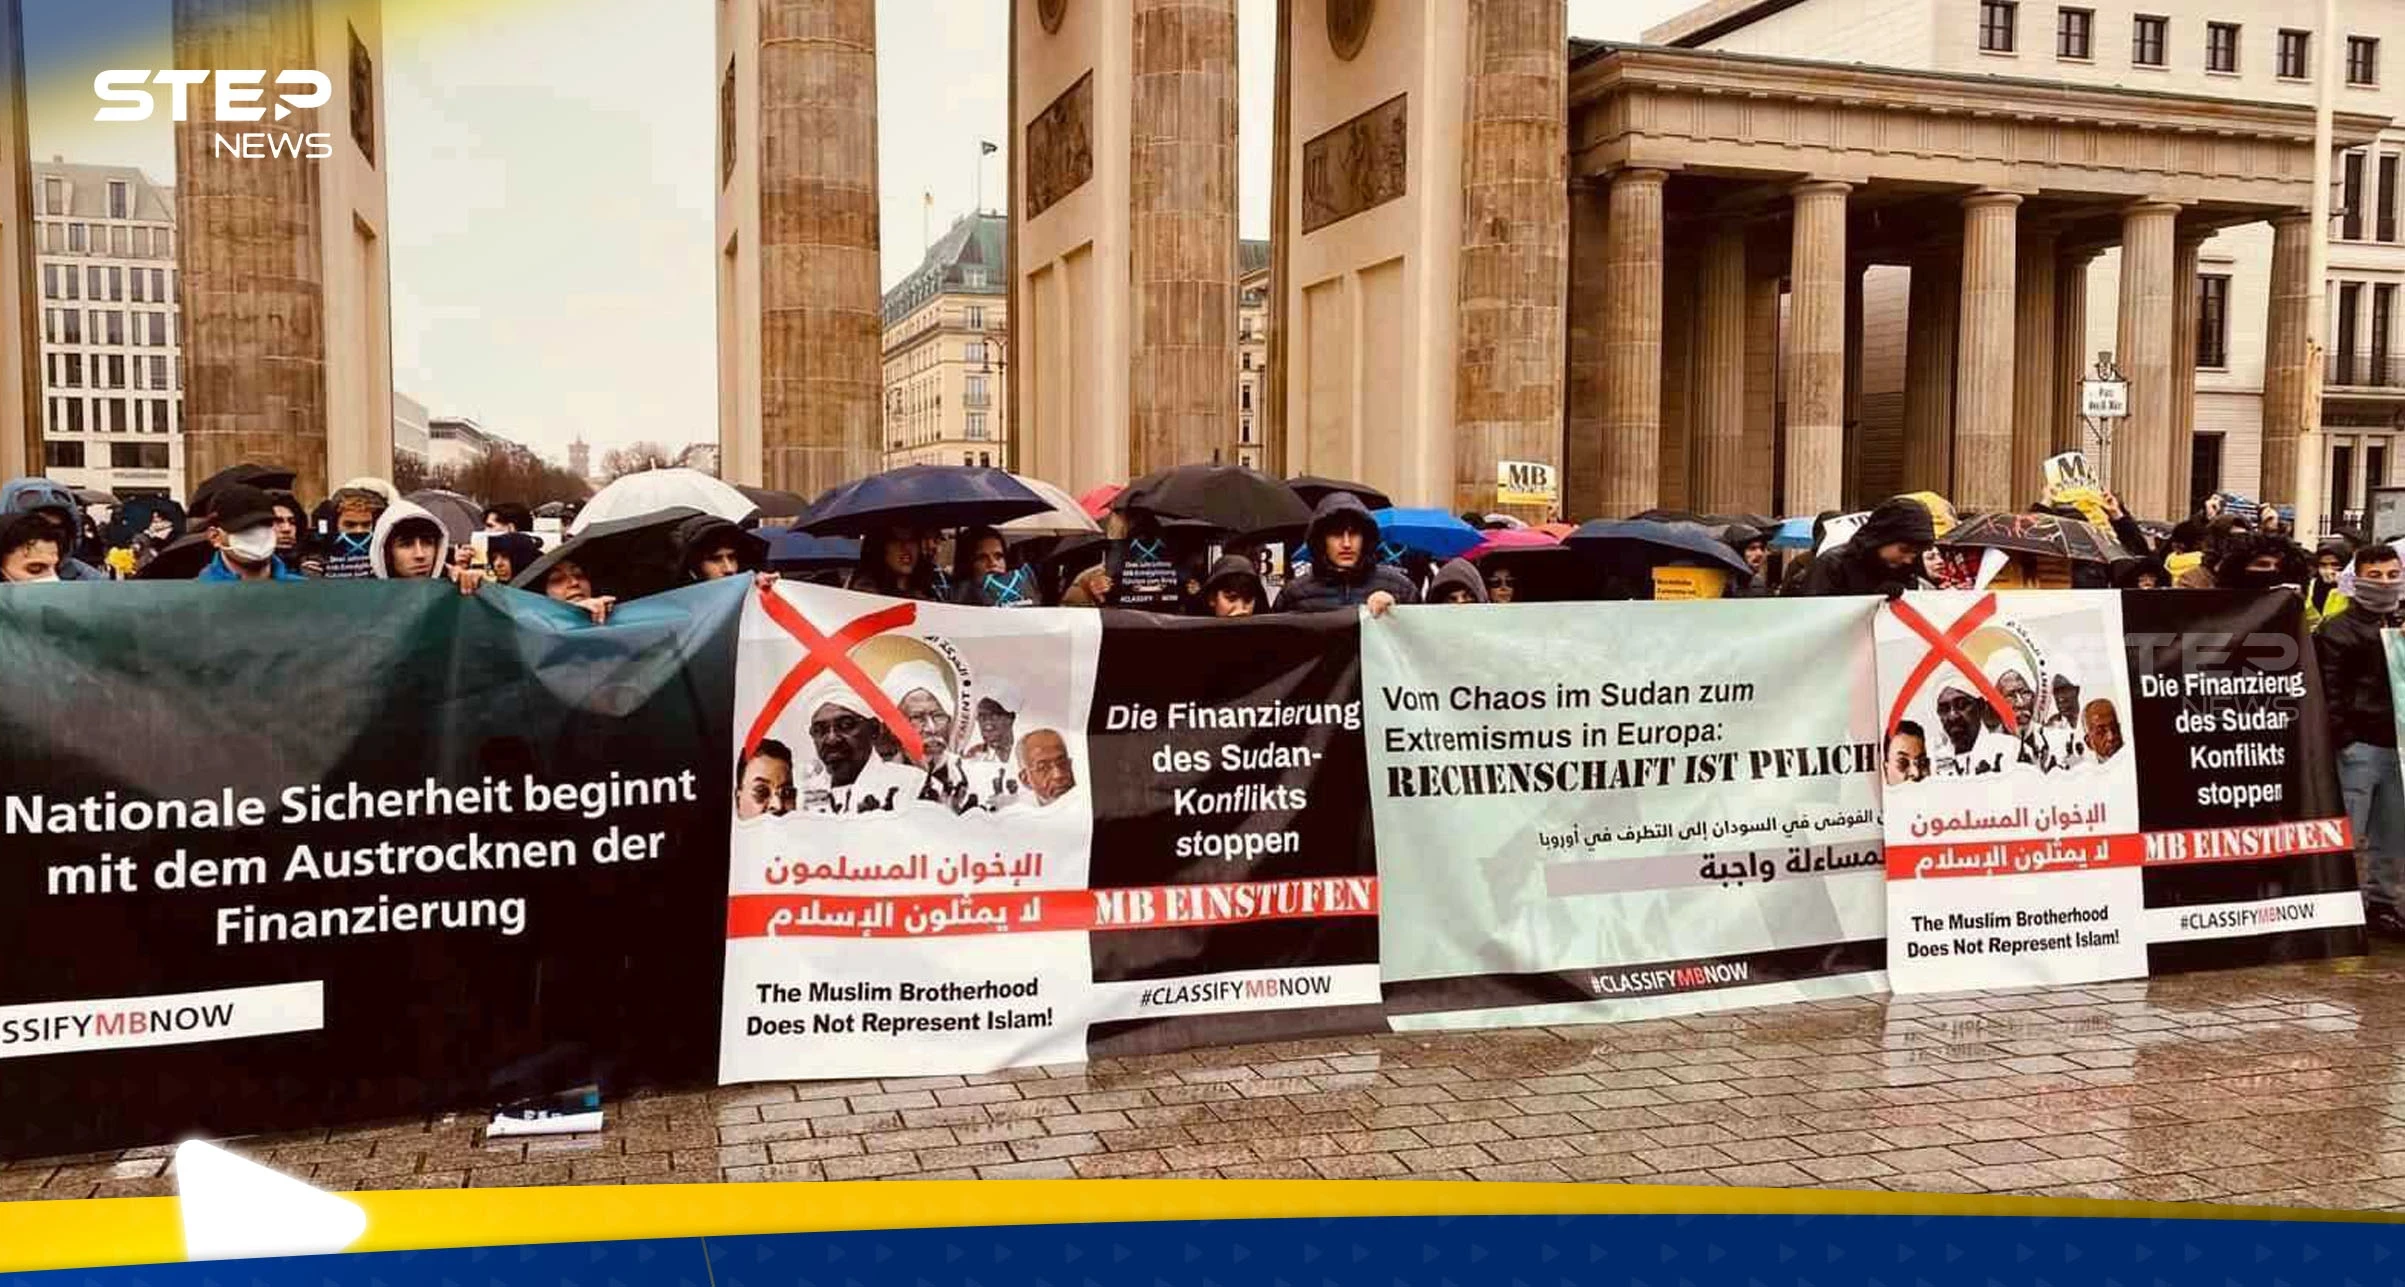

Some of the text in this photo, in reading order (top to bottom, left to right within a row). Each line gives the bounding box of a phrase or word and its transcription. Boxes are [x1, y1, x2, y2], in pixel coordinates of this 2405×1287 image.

[1510, 464, 1547, 486] MB
[1382, 680, 1754, 711] Vom Chaos im Sudan zum
[2141, 673, 2179, 698] Die
[1106, 699, 1362, 731] Die Finanzierung
[2175, 709, 2216, 734] des
[1385, 722, 1723, 752] Extremismus in Europa:
[1152, 742, 1322, 773] des Sudan-
[2190, 742, 2285, 769] Konflikts
[1387, 756, 1676, 798] RECHENSCHAFT
[1684, 752, 1739, 785] IST
[5, 769, 697, 834] Nationale Sicherheit beginnt
[1174, 784, 1308, 816] Konflikts
[1679, 821, 1707, 841] إلى
[1712, 817, 1776, 839] السودان
[1782, 814, 1810, 838] في
[1814, 809, 1873, 831] الفوضى
[1911, 807, 2028, 837] المسلمون
[2035, 802, 2106, 832] الإخوان
[1176, 830, 1300, 861] stoppen
[1585, 827, 1612, 851] في
[1617, 822, 1673, 844] التطرف
[2145, 820, 2345, 861] MB EINSTUFEN
[48, 826, 665, 895] mit dem Austrocknen der
[765, 852, 1043, 886] الإخوان المسلمون
[1700, 851, 1776, 888] واجبة
[1914, 837, 2109, 879] لا يمثلون الإسلام
[767, 892, 1041, 940] لا يمثلون الإسلام
[1094, 878, 1372, 925] MB EINSTUFEN
[2180, 903, 2315, 930] #CLASSIFYMBNOW
[216, 895, 526, 945] Finanzierung
[1911, 905, 2109, 932] The Muslim Brotherhood
[1907, 929, 2119, 958] Does Not Represent Islam!
[756, 977, 1039, 1003] The Muslim Brotherhood
[1140, 976, 1331, 1007] #CLASSIFYMBNOW
[1591, 961, 1749, 993] #CLASSIFYMBNOW
[1, 1003, 234, 1044] SSIFYMBNOW
[747, 1007, 1053, 1037] Does Not Represent Islam!
